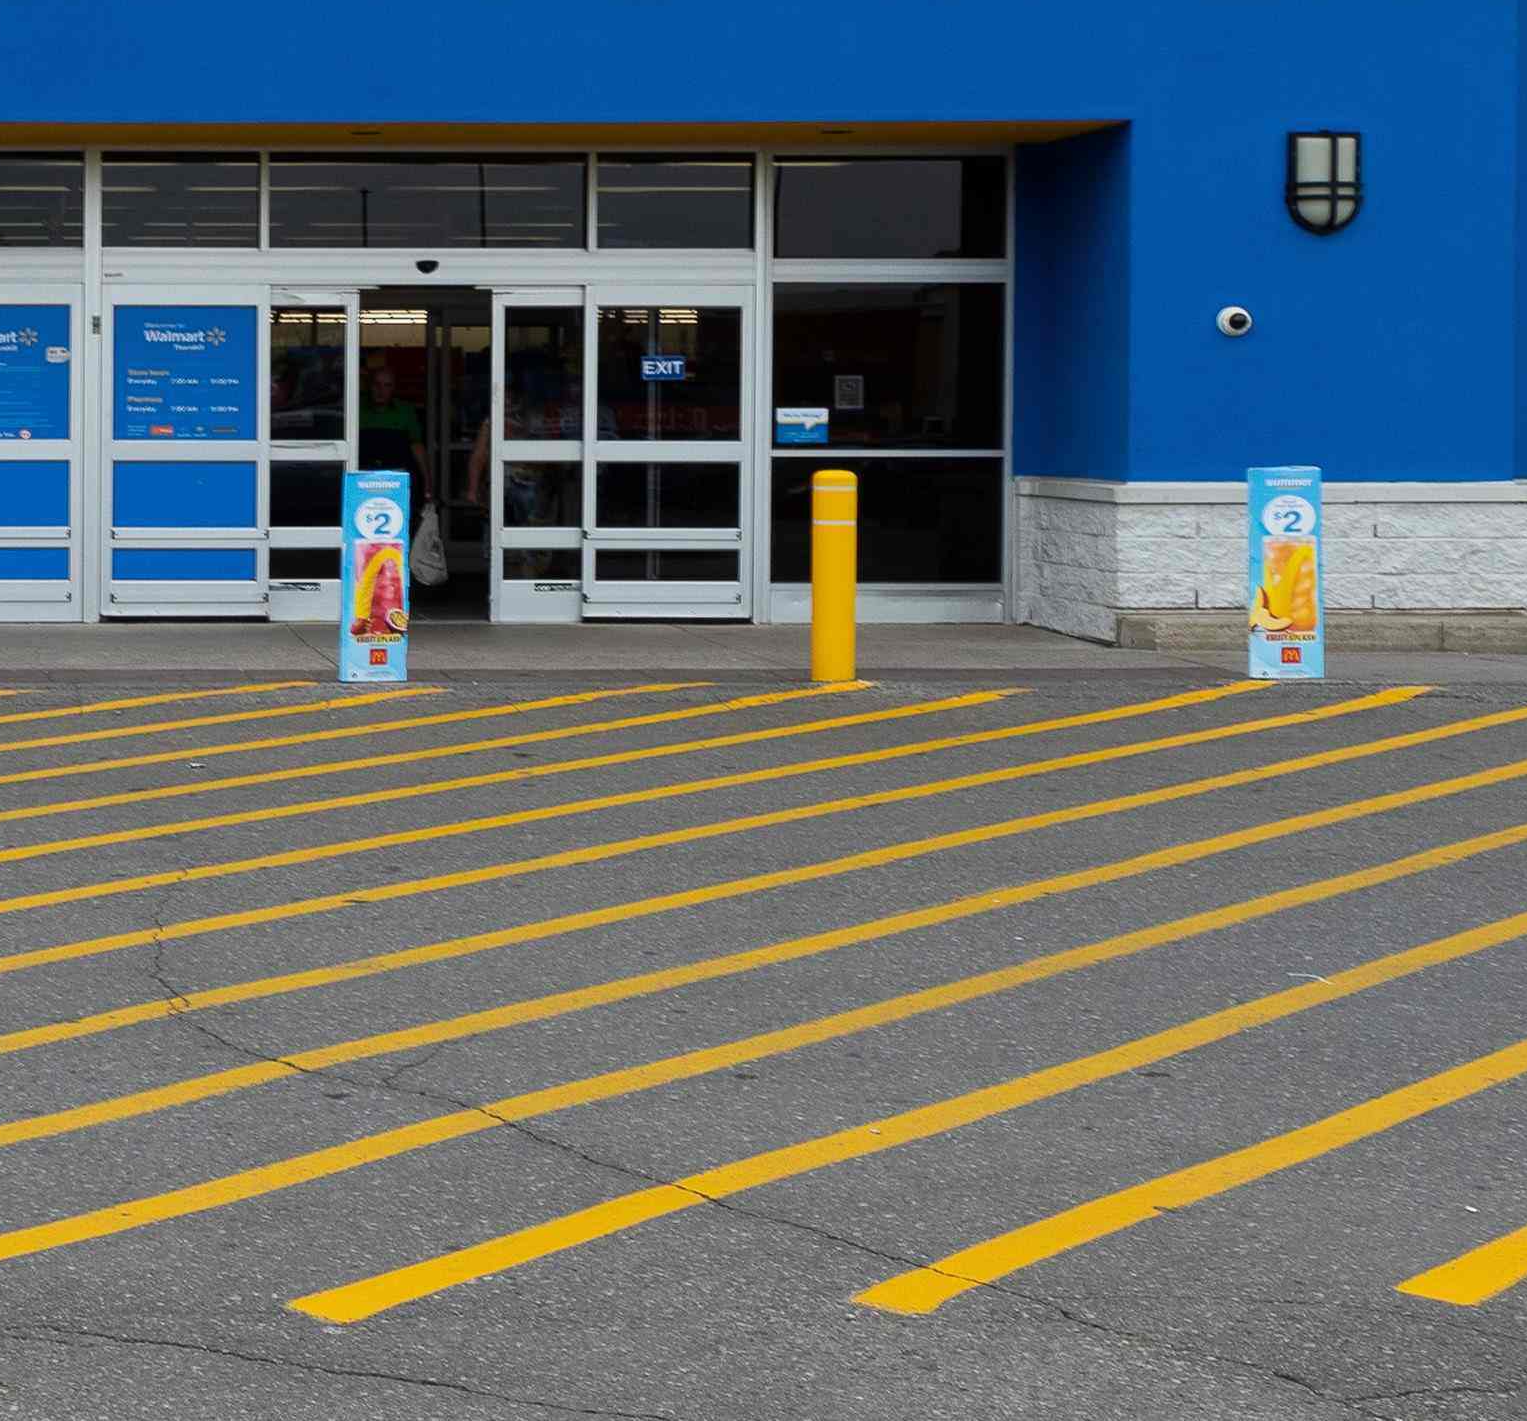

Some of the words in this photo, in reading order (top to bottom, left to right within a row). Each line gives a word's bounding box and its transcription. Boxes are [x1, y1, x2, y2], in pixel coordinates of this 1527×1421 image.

[143, 330, 206, 343] Walmart
[642, 360, 684, 375] EXIT
[365, 513, 391, 534] $2
